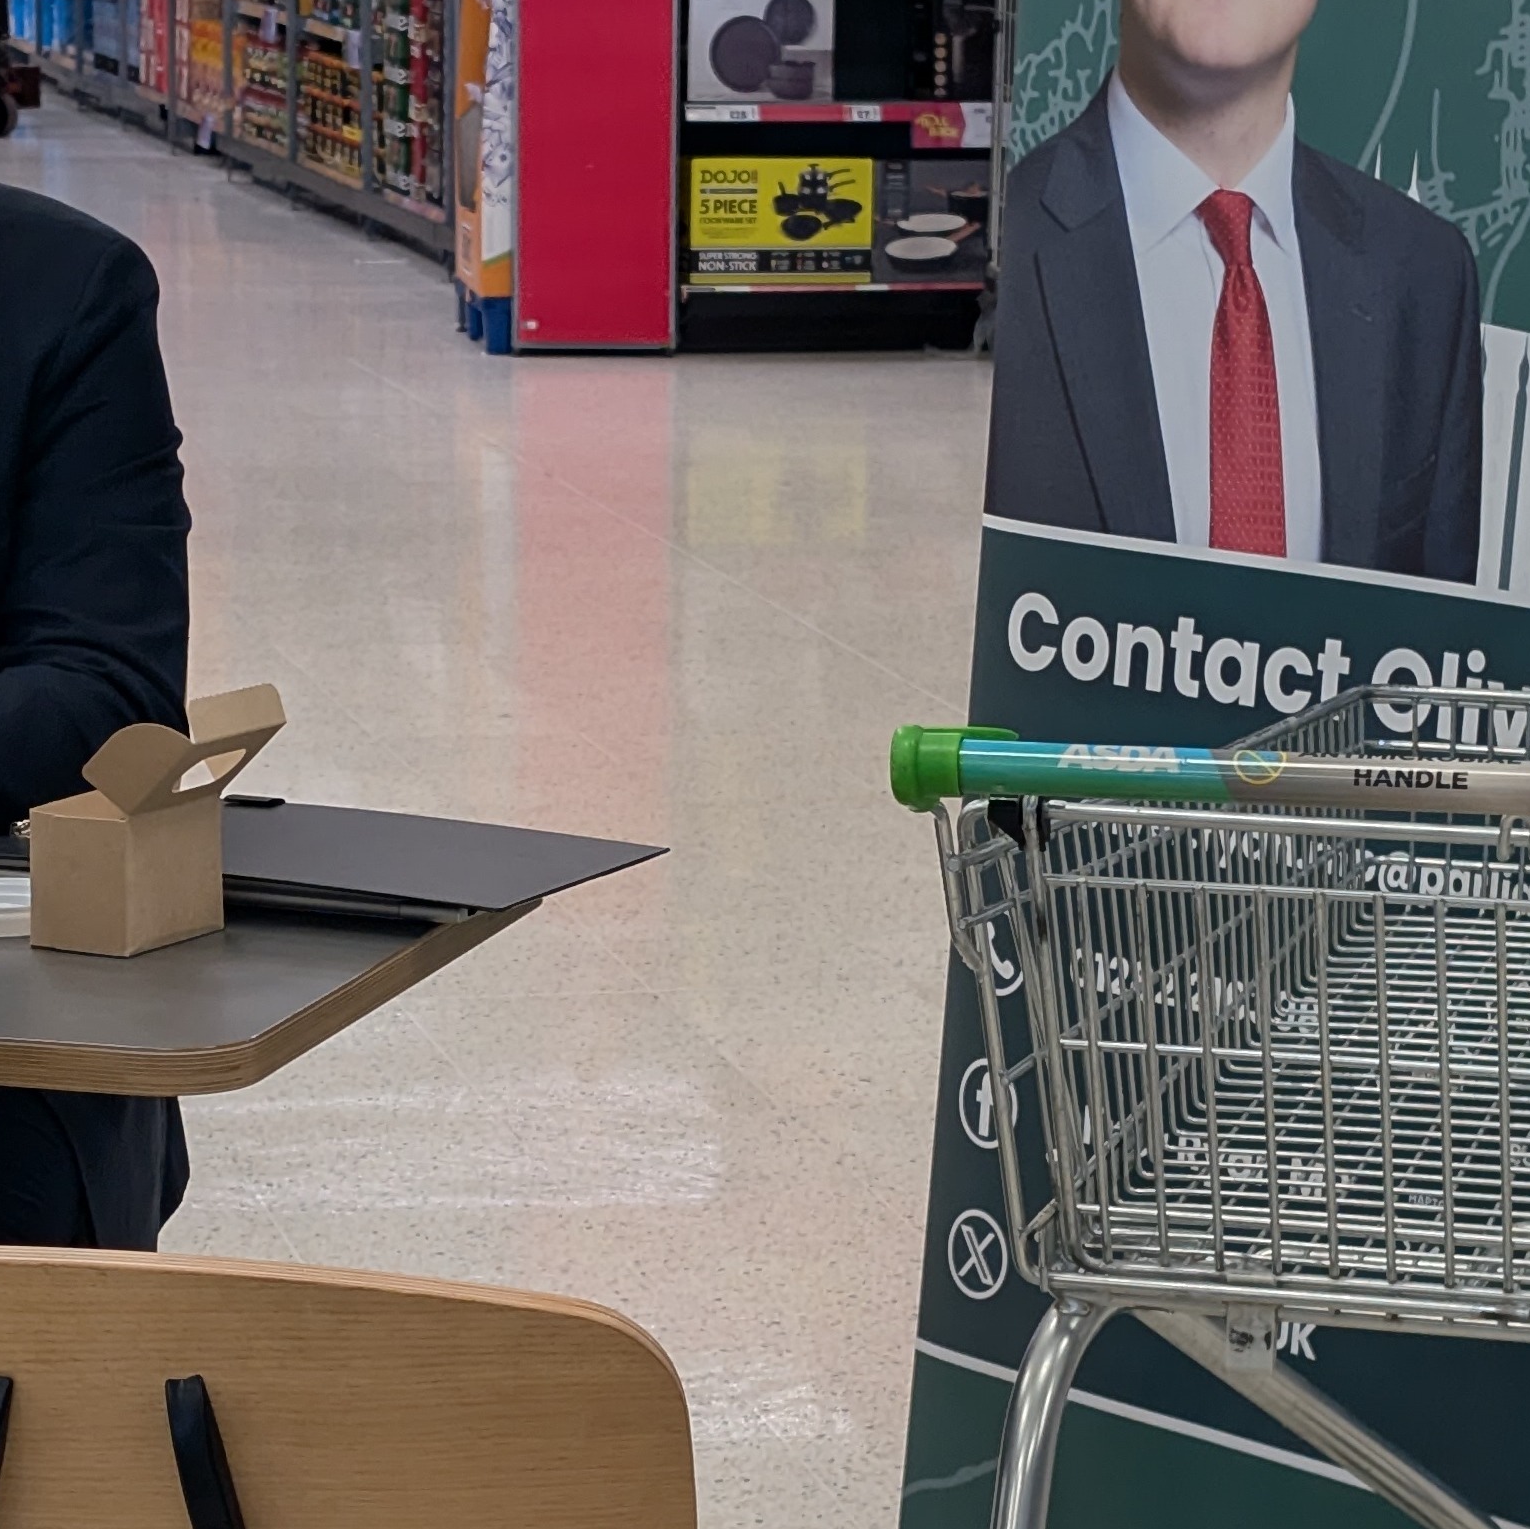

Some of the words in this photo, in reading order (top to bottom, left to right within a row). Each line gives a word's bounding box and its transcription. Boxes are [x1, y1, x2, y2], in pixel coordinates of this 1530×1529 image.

[699, 169, 751, 185] DOJO
[699, 199, 710, 215] 5
[713, 198, 758, 215] PIECE
[698, 261, 757, 271] NON-STICK
[1008, 591, 1352, 722] Contact
[1057, 742, 1183, 774] ASDA
[1353, 768, 1469, 790] HANDLE
